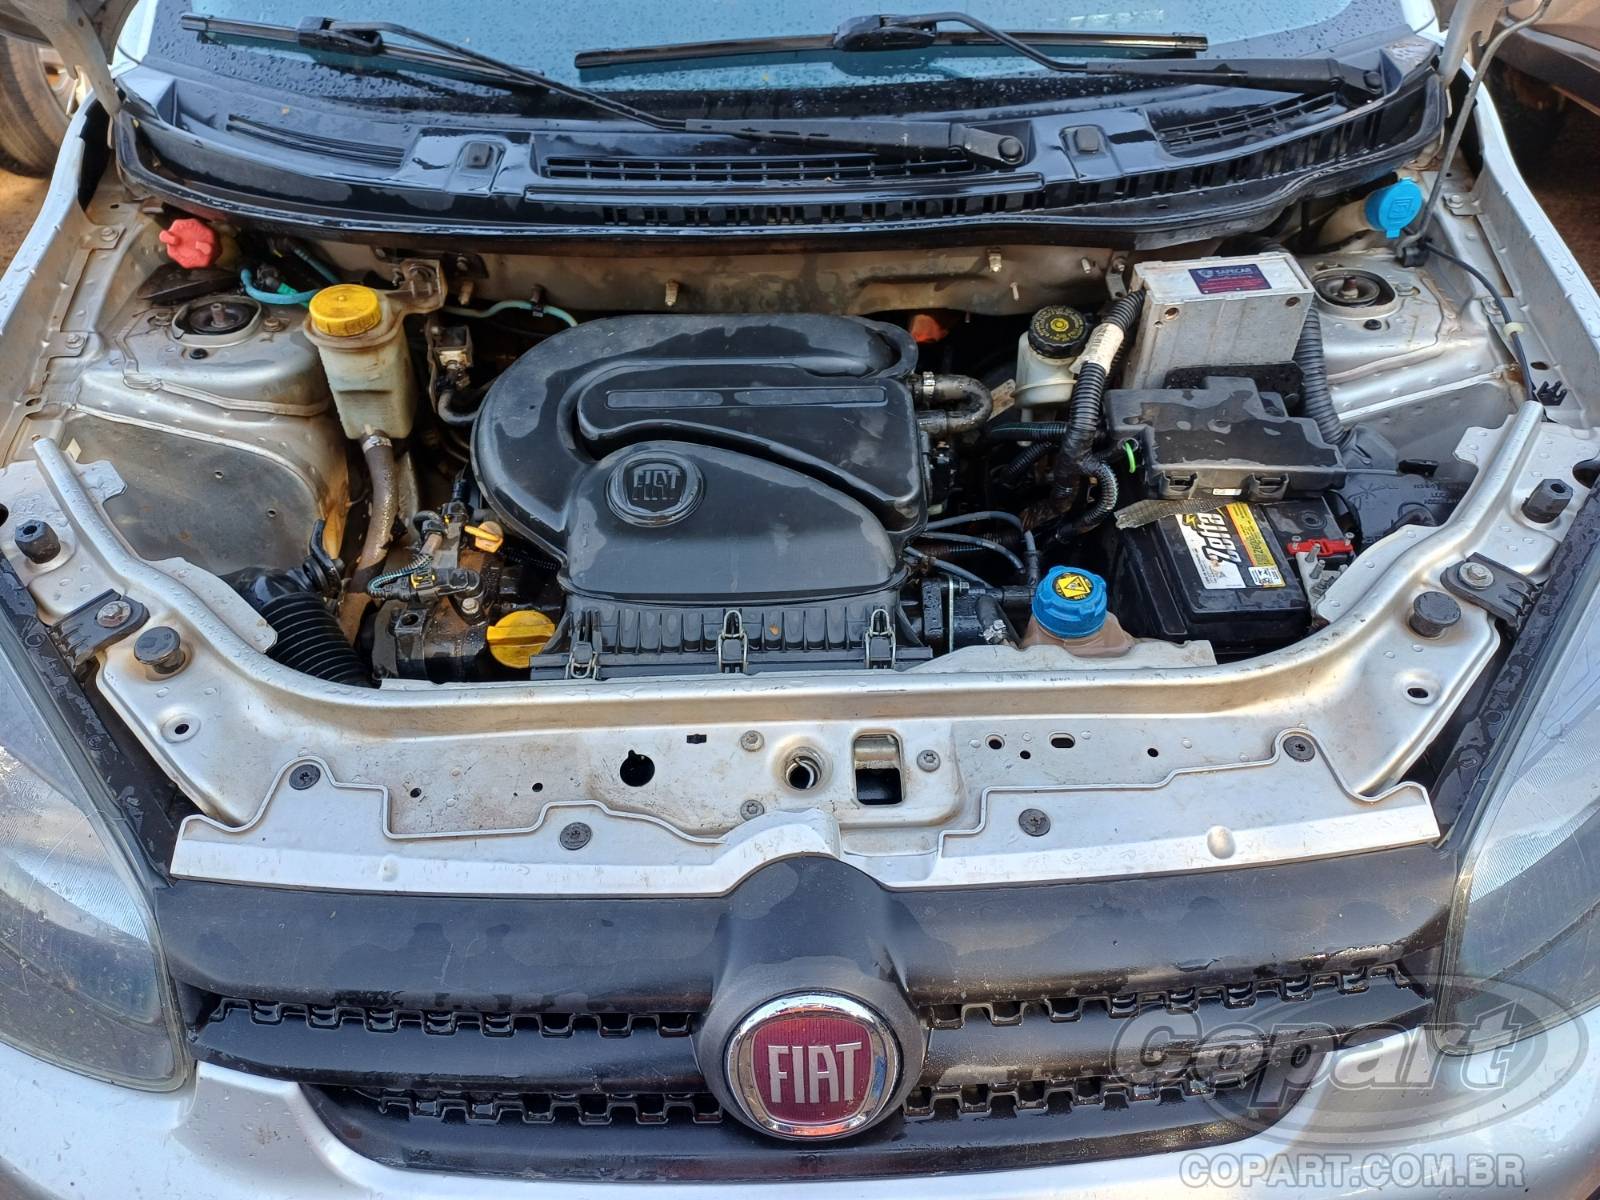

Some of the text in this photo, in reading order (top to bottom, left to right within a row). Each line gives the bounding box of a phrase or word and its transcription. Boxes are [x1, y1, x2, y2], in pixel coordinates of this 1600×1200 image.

[633, 469, 682, 501] FIAT
[1196, 512, 1242, 563] Zetta
[767, 1041, 862, 1104] FIAT
